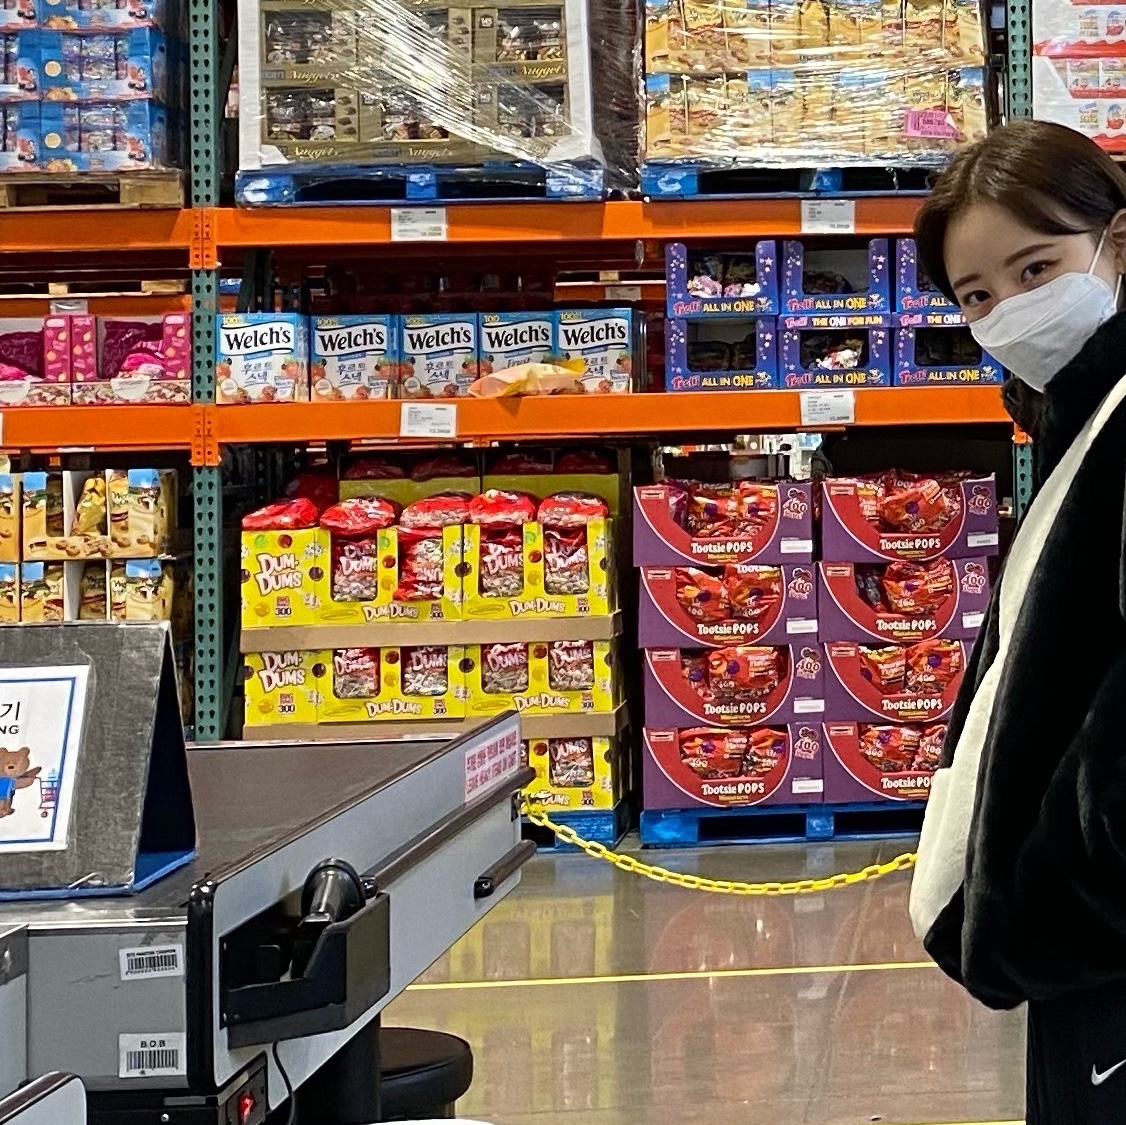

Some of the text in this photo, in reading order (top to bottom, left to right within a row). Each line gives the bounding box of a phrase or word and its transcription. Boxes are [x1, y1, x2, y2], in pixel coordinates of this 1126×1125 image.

[703, 302, 719, 312] ALL
[721, 302, 732, 312] IN
[733, 301, 755, 312] ONE
[815, 299, 832, 309] ALL
[833, 299, 844, 309] IN
[846, 297, 867, 310] ONE
[930, 297, 947, 306] ALL
[812, 317, 828, 326] THE
[829, 316, 847, 327] ONE
[848, 316, 864, 326] FOR
[865, 316, 883, 325] FUN
[926, 315, 942, 324] THE
[943, 315, 961, 324] ONE
[225, 326, 291, 351] Welch's
[319, 328, 384, 352] Welch's
[408, 327, 472, 350] Welch's
[485, 323, 549, 349] Welch's
[563, 322, 626, 346] Welch's
[702, 377, 718, 387] ALL
[720, 377, 731, 387] IN
[733, 375, 754, 388] ONE
[815, 373, 832, 384] ALL
[833, 374, 843, 383] IN
[845, 372, 867, 385] ONE
[928, 371, 946, 381] ALL
[947, 371, 957, 380] IN
[959, 369, 980, 381] ONE
[691, 541, 753, 554] Tootsie POPS
[880, 538, 941, 550] Tootsie POPS
[255, 571, 303, 596] DUMS
[697, 623, 759, 635] Tootsie POPS
[876, 619, 937, 630] Tootsie POPS
[259, 669, 306, 693] DUMS
[703, 702, 767, 715] Tootsie POPS
[881, 698, 943, 710] Tootsie POPS
[701, 782, 765, 795] Tootsie POPS
[881, 776, 932, 789] Tootsie PO
